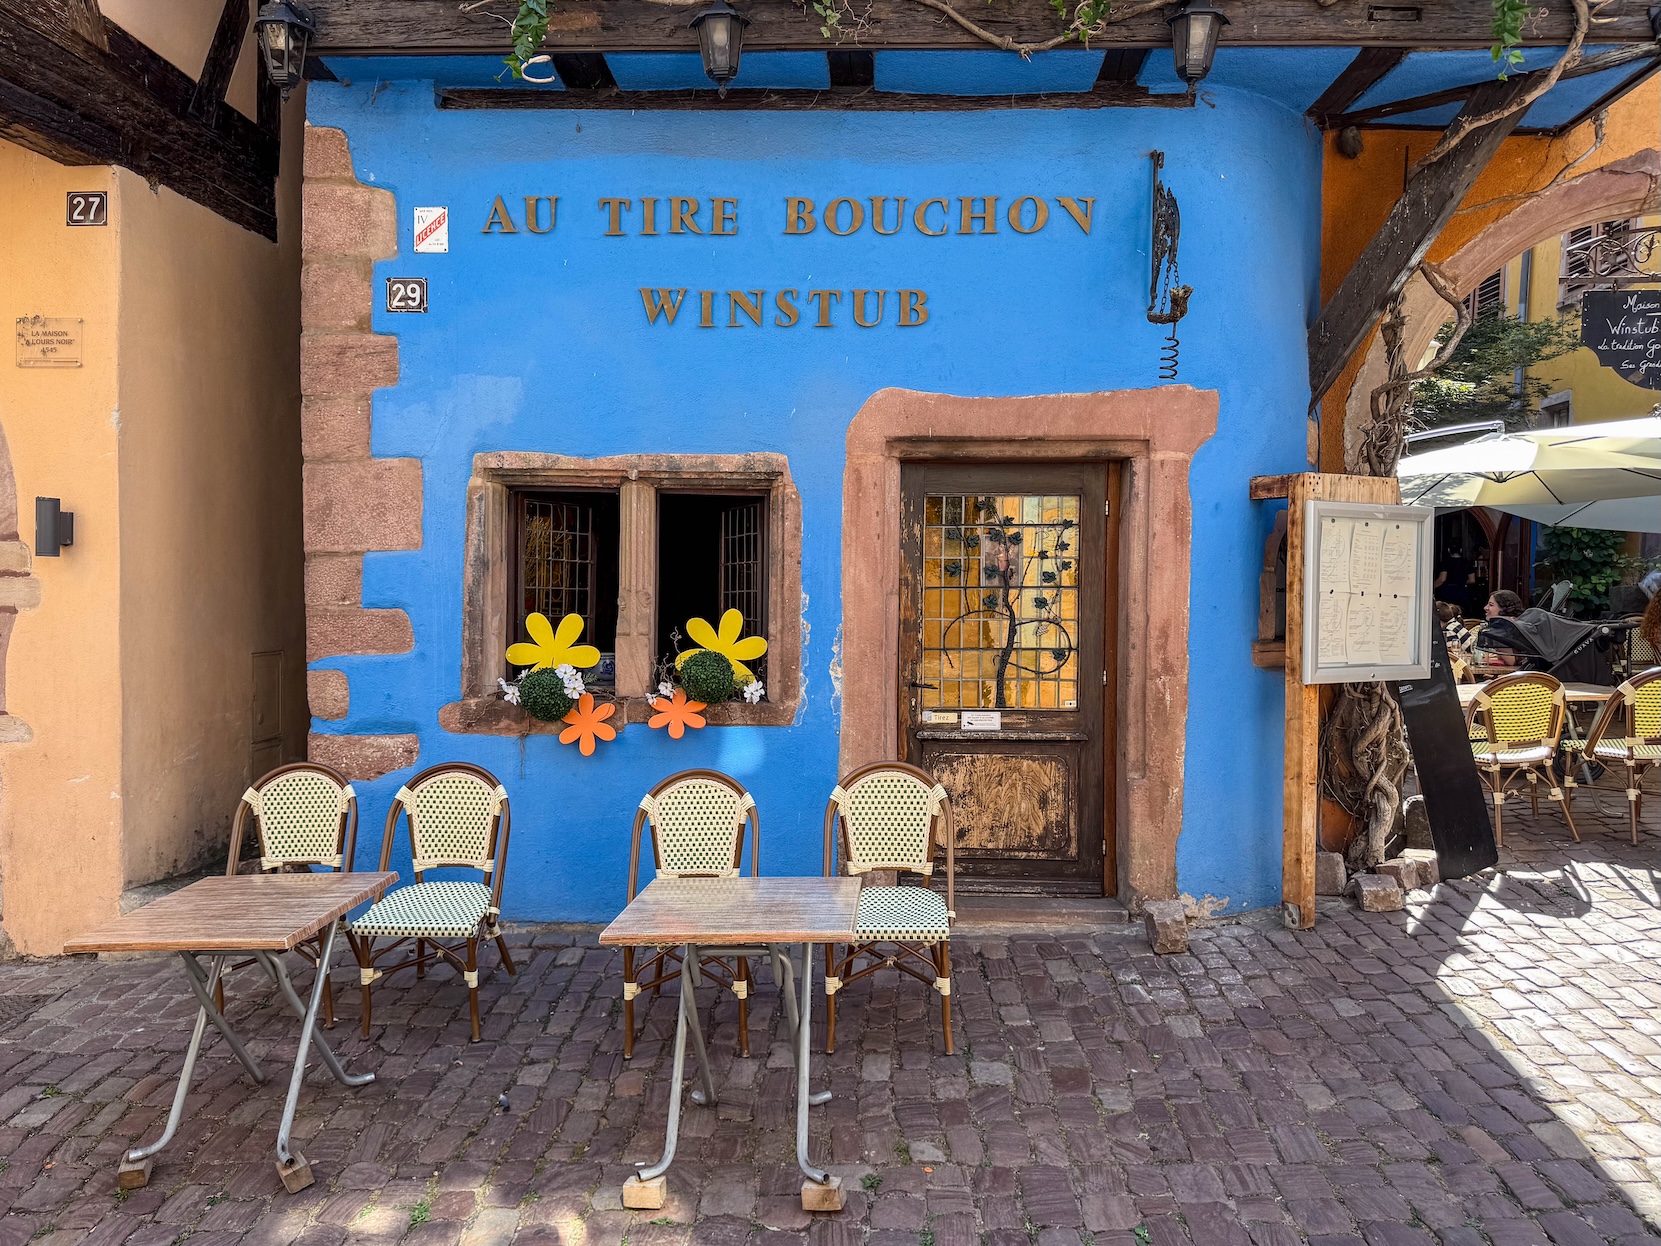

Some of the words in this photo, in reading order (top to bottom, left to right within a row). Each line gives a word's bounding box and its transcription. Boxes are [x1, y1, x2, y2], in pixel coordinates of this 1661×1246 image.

[72, 196, 101, 220] 27
[417, 215, 428, 224] IV
[480, 194, 559, 234] AU
[598, 196, 738, 236] TIRE
[782, 195, 1097, 236] BOUCHON
[416, 212, 446, 246] LICENCE
[392, 283, 421, 307] 29
[1622, 294, 1660, 313] Maison
[638, 287, 929, 328] WINSTUB
[1605, 315, 1660, 335] Winstub
[1611, 339, 1644, 350] tradition
